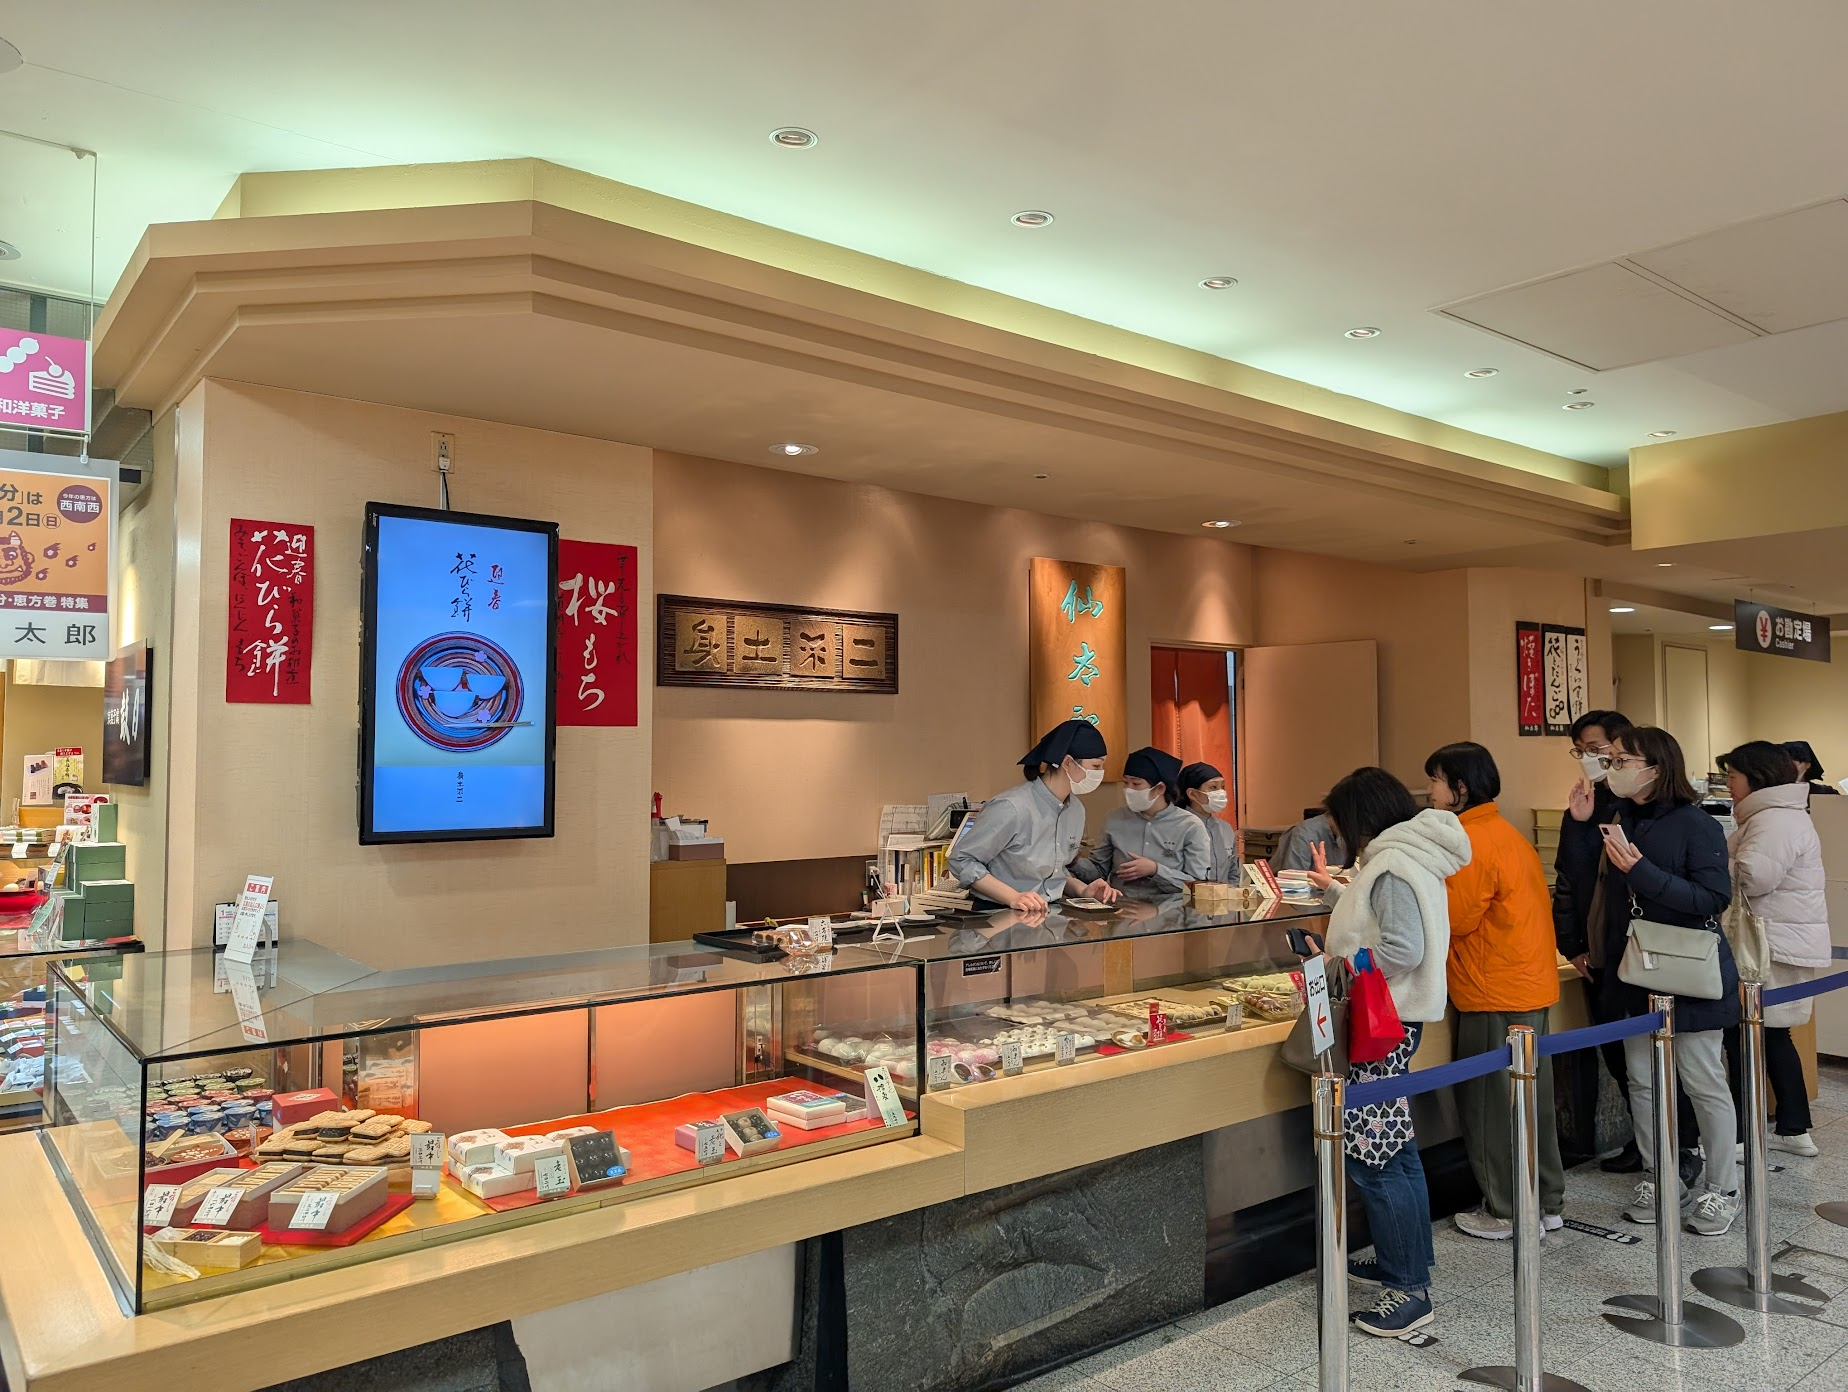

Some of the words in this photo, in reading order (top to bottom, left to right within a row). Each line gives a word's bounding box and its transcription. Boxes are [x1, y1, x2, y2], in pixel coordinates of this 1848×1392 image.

[0, 398, 65, 420] 和洋菓子
[63, 493, 97, 501] 今年の恵方は
[60, 499, 100, 514] 西南西
[285, 534, 308, 585] 迎春
[60, 596, 90, 610] 特集
[1775, 616, 1812, 643] お勘定場
[558, 572, 619, 712] 桜もち
[1775, 638, 1795, 650] Cashier
